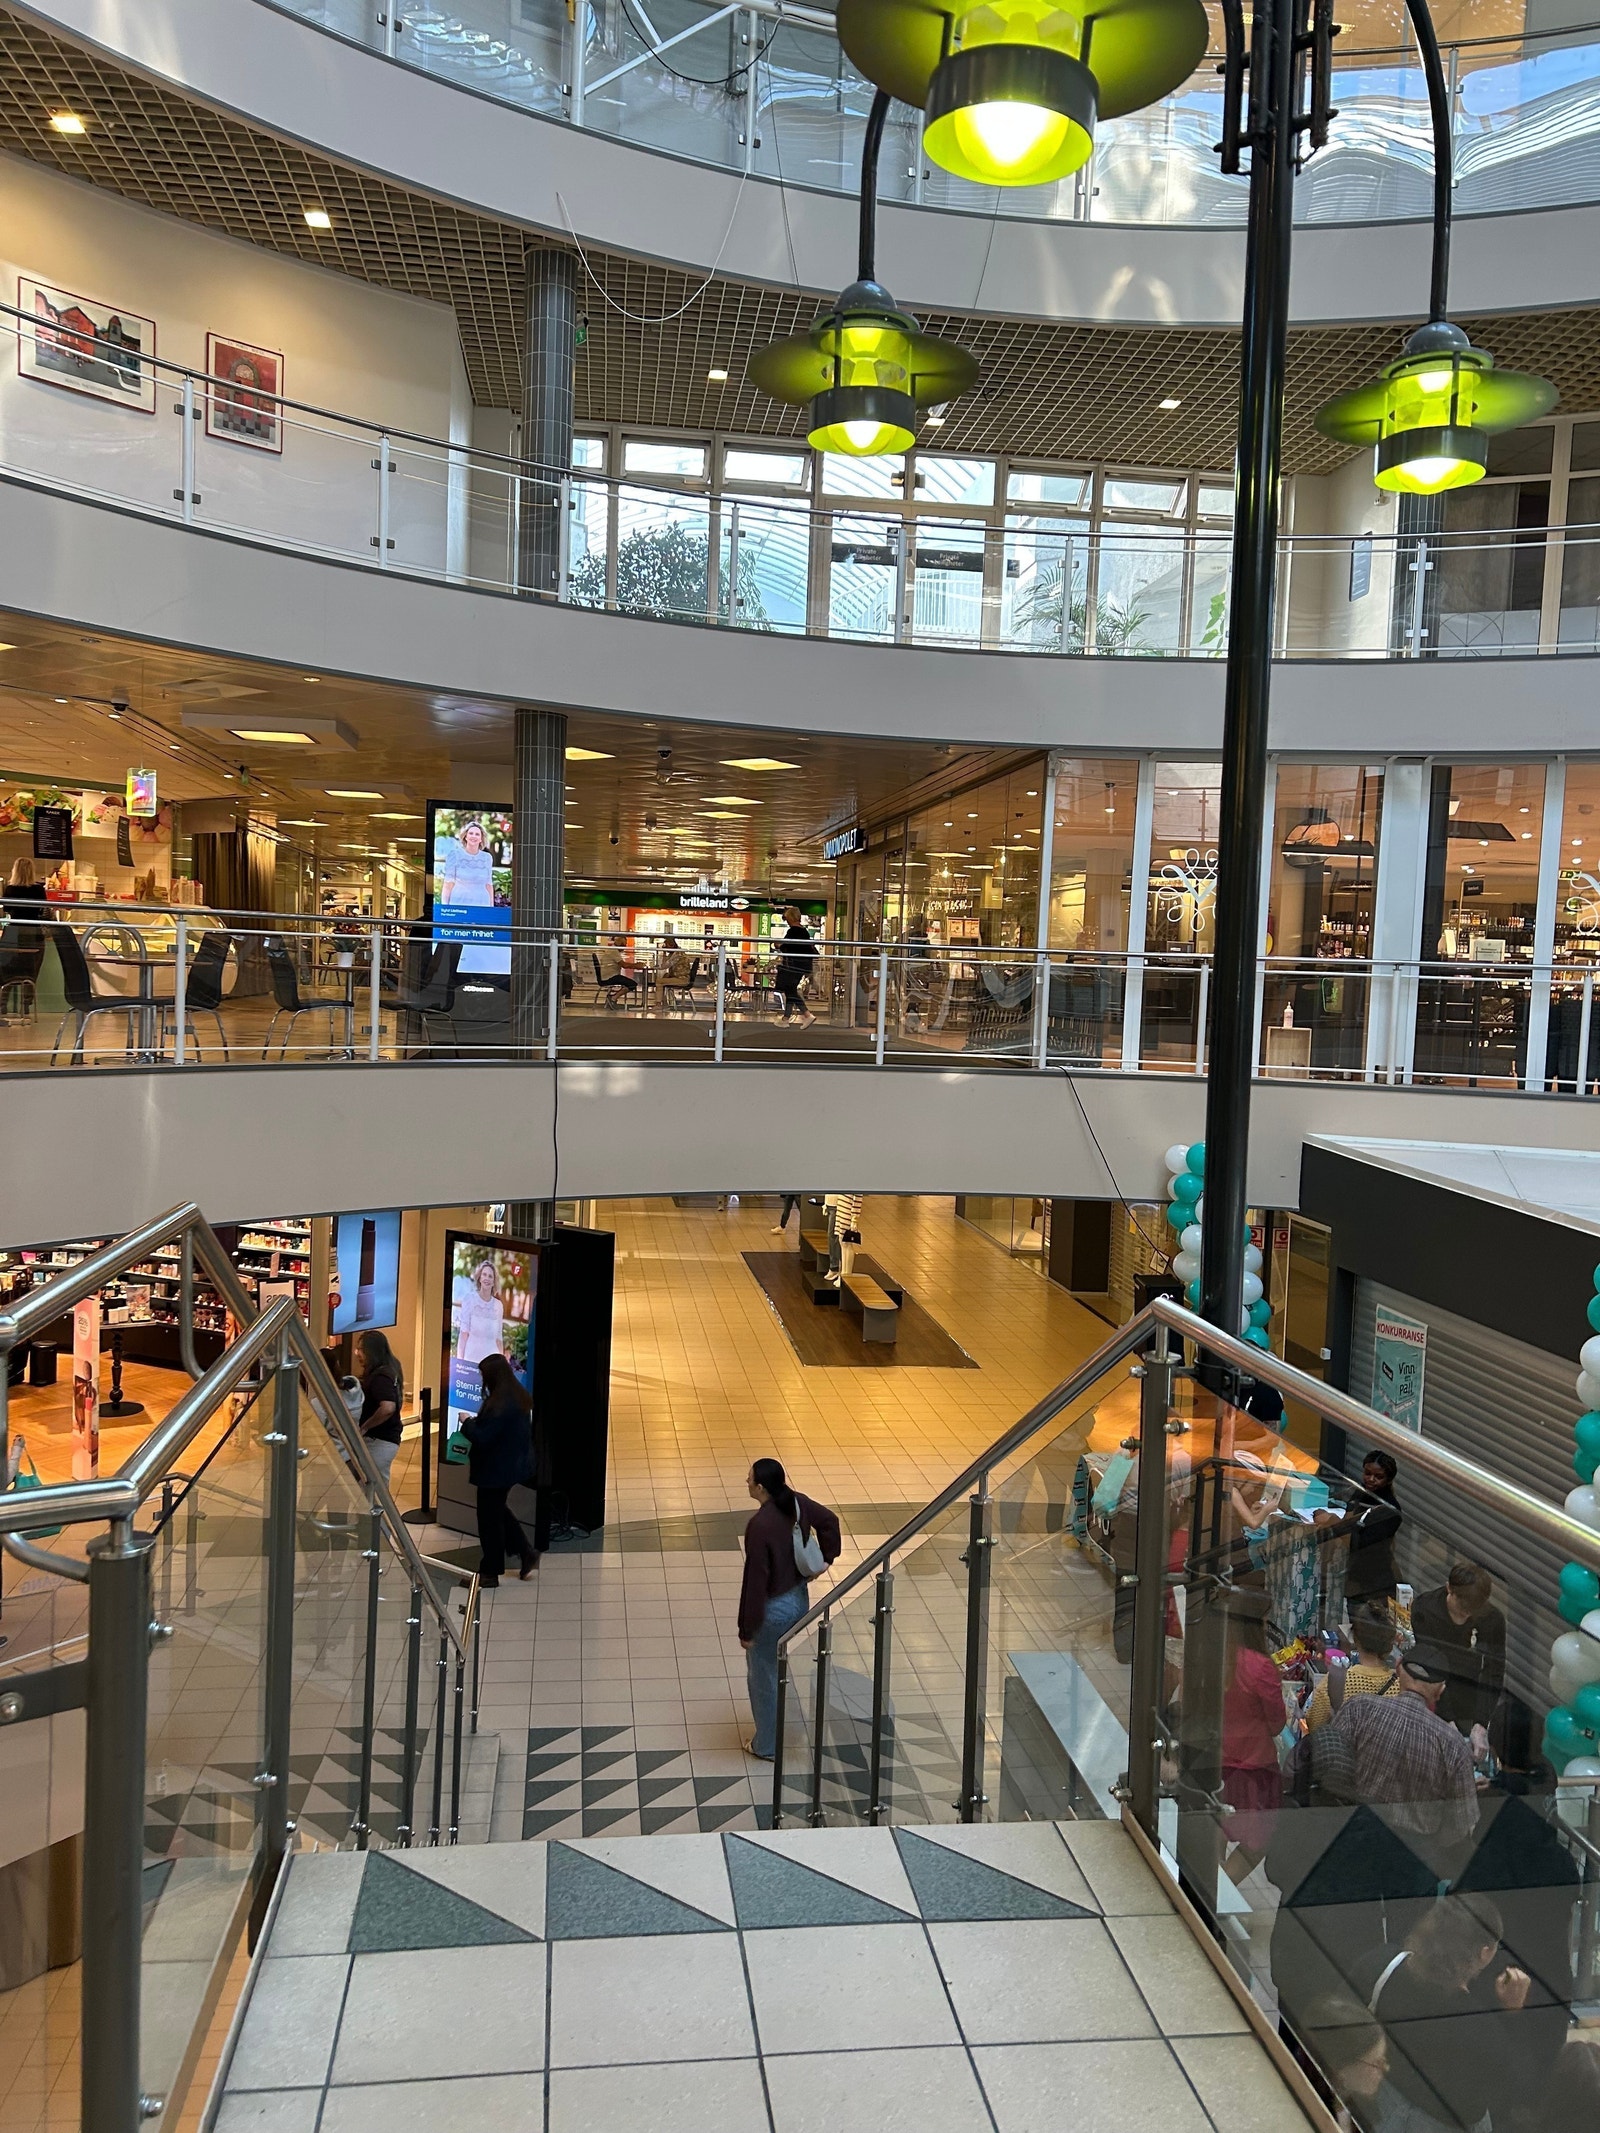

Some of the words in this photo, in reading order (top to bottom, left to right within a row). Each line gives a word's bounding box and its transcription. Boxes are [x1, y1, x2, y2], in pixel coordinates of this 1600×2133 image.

[679, 895, 729, 909] brilleland
[471, 929, 495, 938] frihet
[1376, 1322, 1425, 1344] KONKURRANSE
[1398, 1362, 1416, 1375] Vinn
[455, 1379, 474, 1391] Stem
[474, 1383, 483, 1393] Fr
[455, 1389, 467, 1398] for
[467, 1392, 482, 1402] mer
